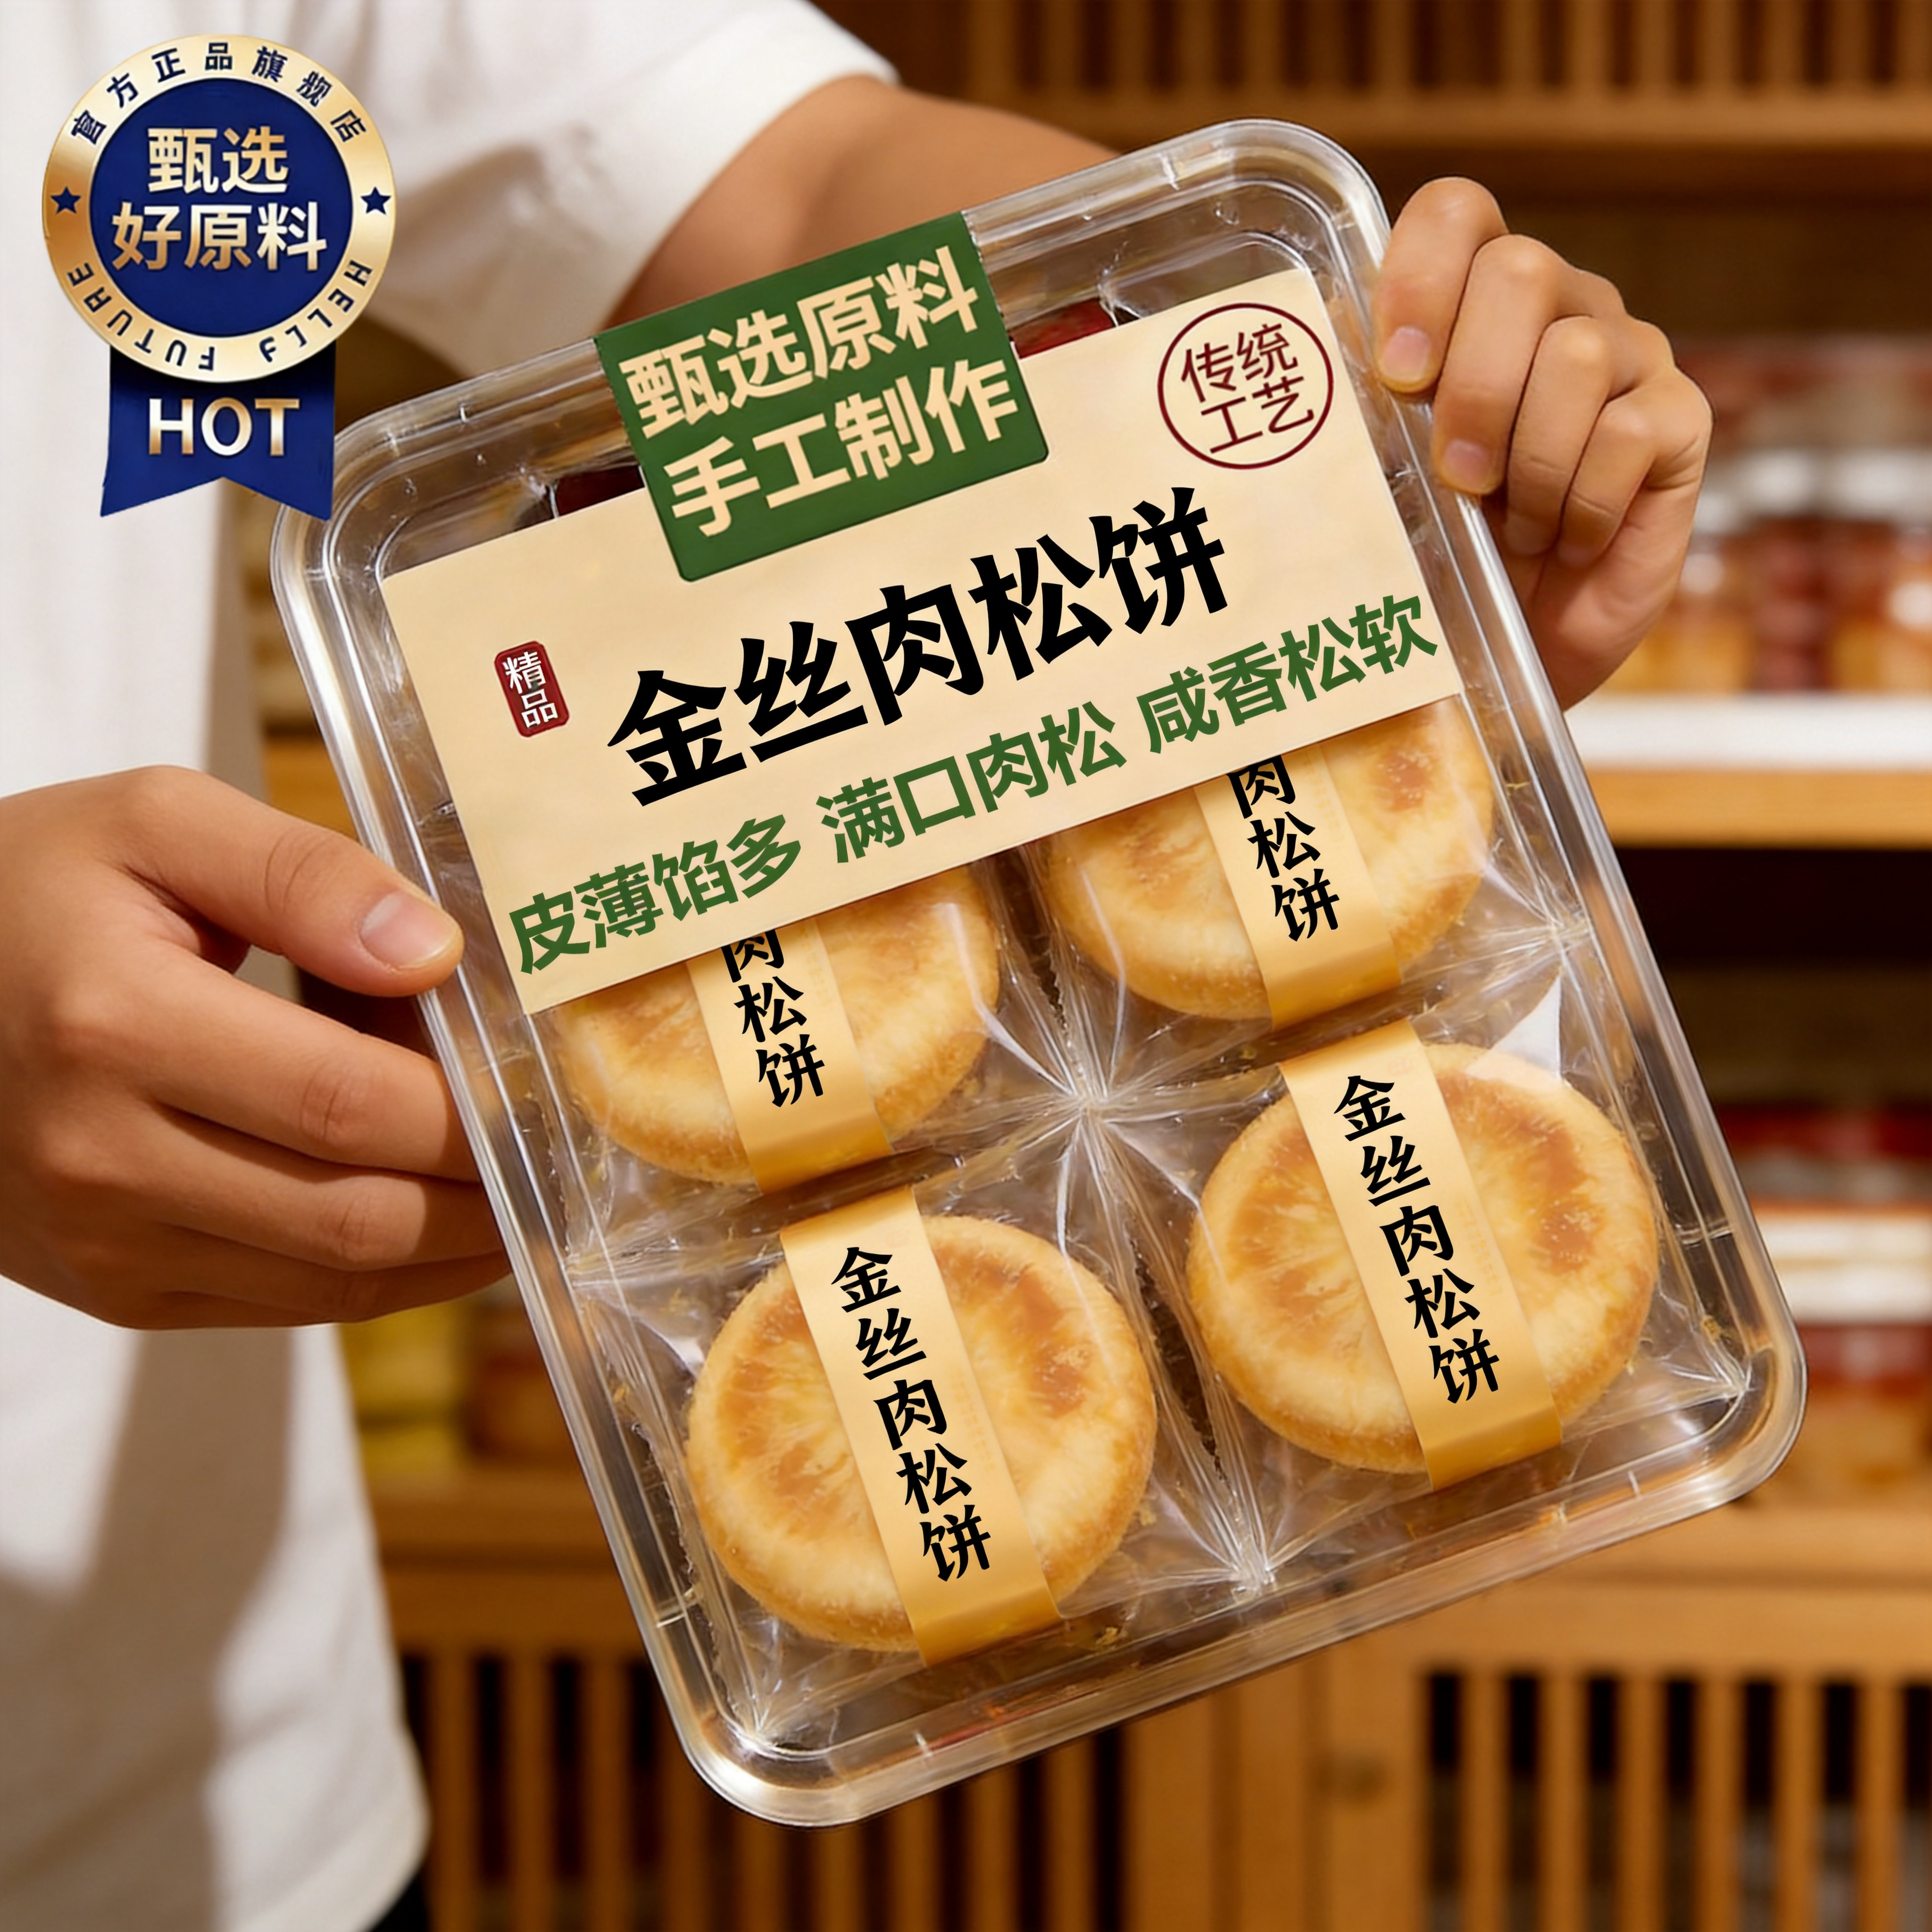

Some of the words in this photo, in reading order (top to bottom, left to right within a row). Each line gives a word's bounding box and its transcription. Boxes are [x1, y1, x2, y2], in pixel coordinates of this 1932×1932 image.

[619, 246, 978, 438] 甄选原料
[1182, 324, 1298, 402] 传统
[1201, 376, 1314, 453] 工艺
[664, 359, 1018, 537] 手工制作
[503, 651, 558, 728] 精品
[608, 487, 1227, 807] 金丝肉松饼
[509, 815, 801, 974] 皮薄馅多
[816, 701, 1126, 863] 满口肉松
[1137, 595, 1437, 753] 咸香松软
[1334, 1075, 1499, 1404] 金丝肉松饼
[831, 1247, 991, 1582] 金丝肉松饼
